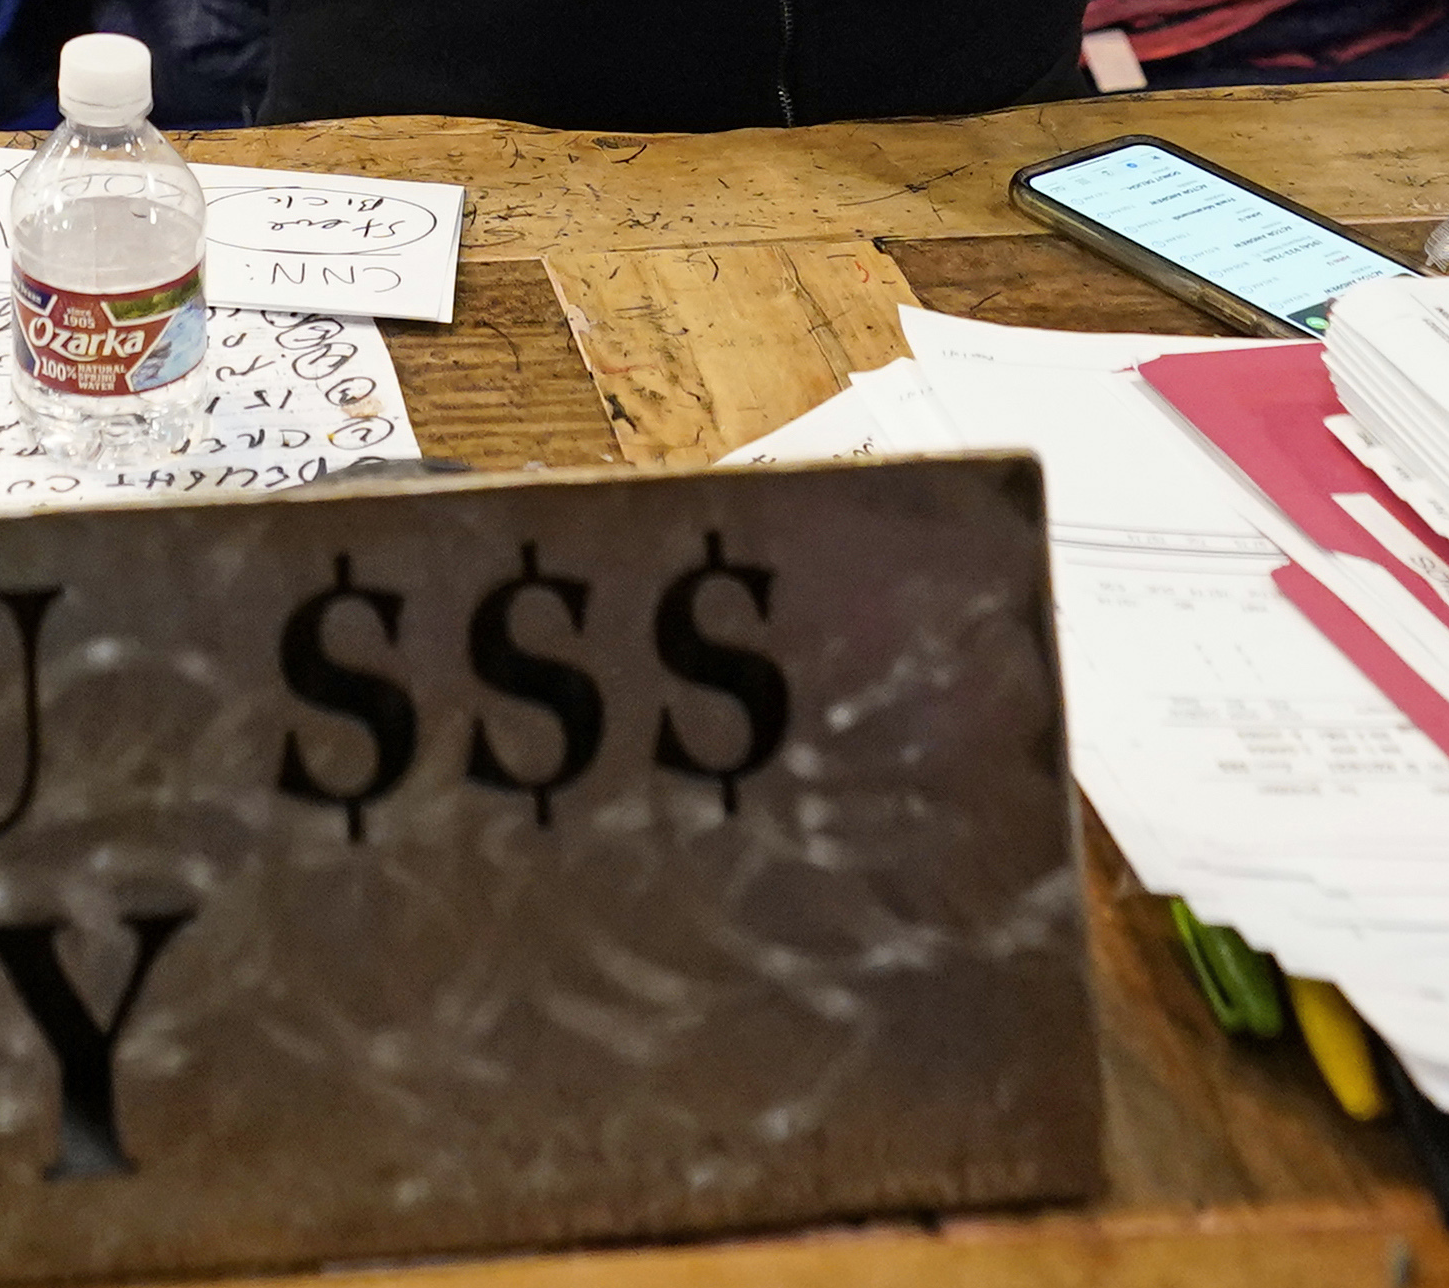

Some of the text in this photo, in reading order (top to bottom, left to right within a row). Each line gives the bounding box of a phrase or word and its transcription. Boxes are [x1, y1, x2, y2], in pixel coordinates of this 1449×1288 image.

[29, 316, 145, 362] Ozarka
[42, 356, 77, 381] 100%
[78, 363, 127, 374] NATURAL
[78, 372, 116, 383] SPRING
[78, 380, 115, 391] WATER
